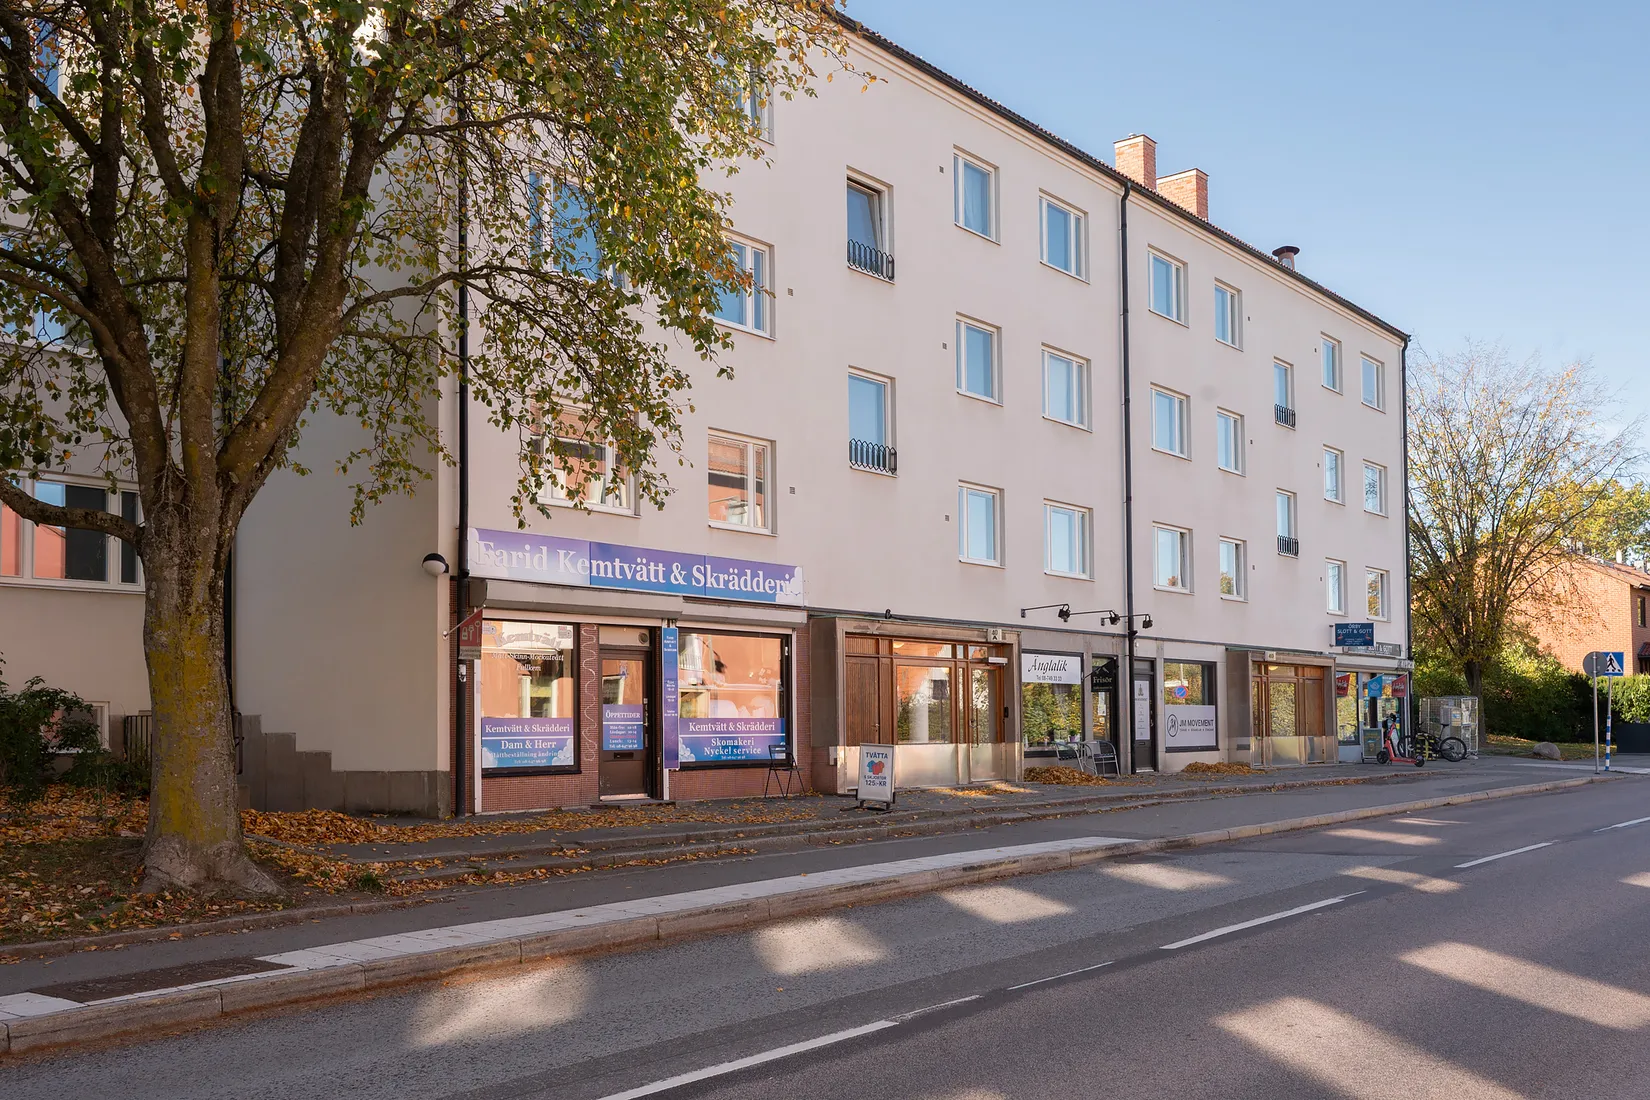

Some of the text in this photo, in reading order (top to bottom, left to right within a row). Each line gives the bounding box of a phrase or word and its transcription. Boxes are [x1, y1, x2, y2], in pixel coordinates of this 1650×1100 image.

[477, 539, 791, 595] Farid Kemtvätt & Skrädderi
[1028, 656, 1068, 674] Änglalik
[1093, 676, 1113, 684] Frisör
[606, 710, 641, 718] ÖPPETTIDER
[485, 723, 570, 733] Kemtvätt & Skrädderi
[689, 721, 775, 732] Kemtvätt & Skrädderi
[1187, 719, 1214, 727] MOVEMENT
[501, 739, 557, 750] Dam & Herr
[711, 738, 755, 747] Skomakeri
[704, 746, 761, 757] Nyckel service
